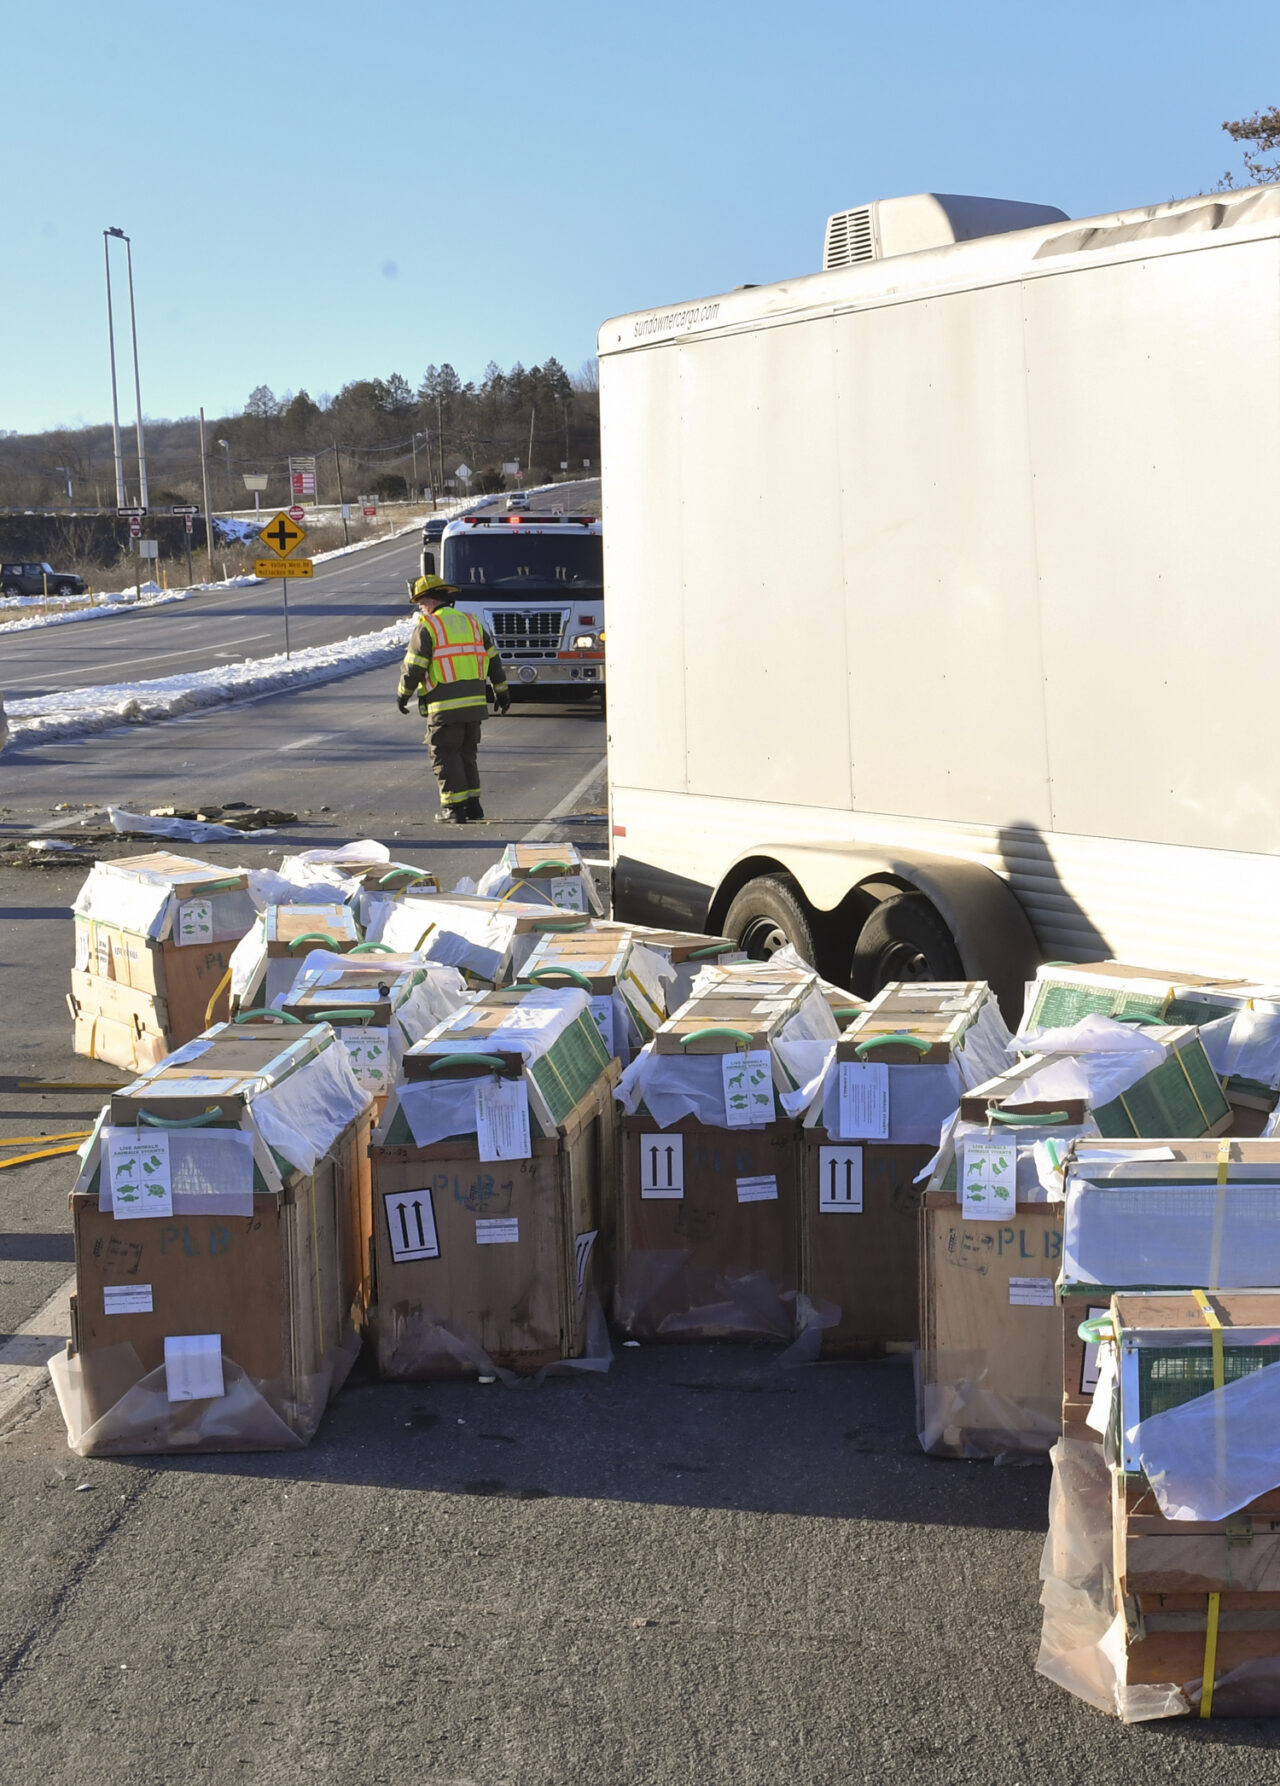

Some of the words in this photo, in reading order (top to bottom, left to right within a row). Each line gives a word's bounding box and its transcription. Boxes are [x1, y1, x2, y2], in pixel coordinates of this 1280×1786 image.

[634, 303, 720, 338] sundownercargo.com
[161, 1224, 231, 1257] PLB
[998, 1227, 1063, 1259] PLB
